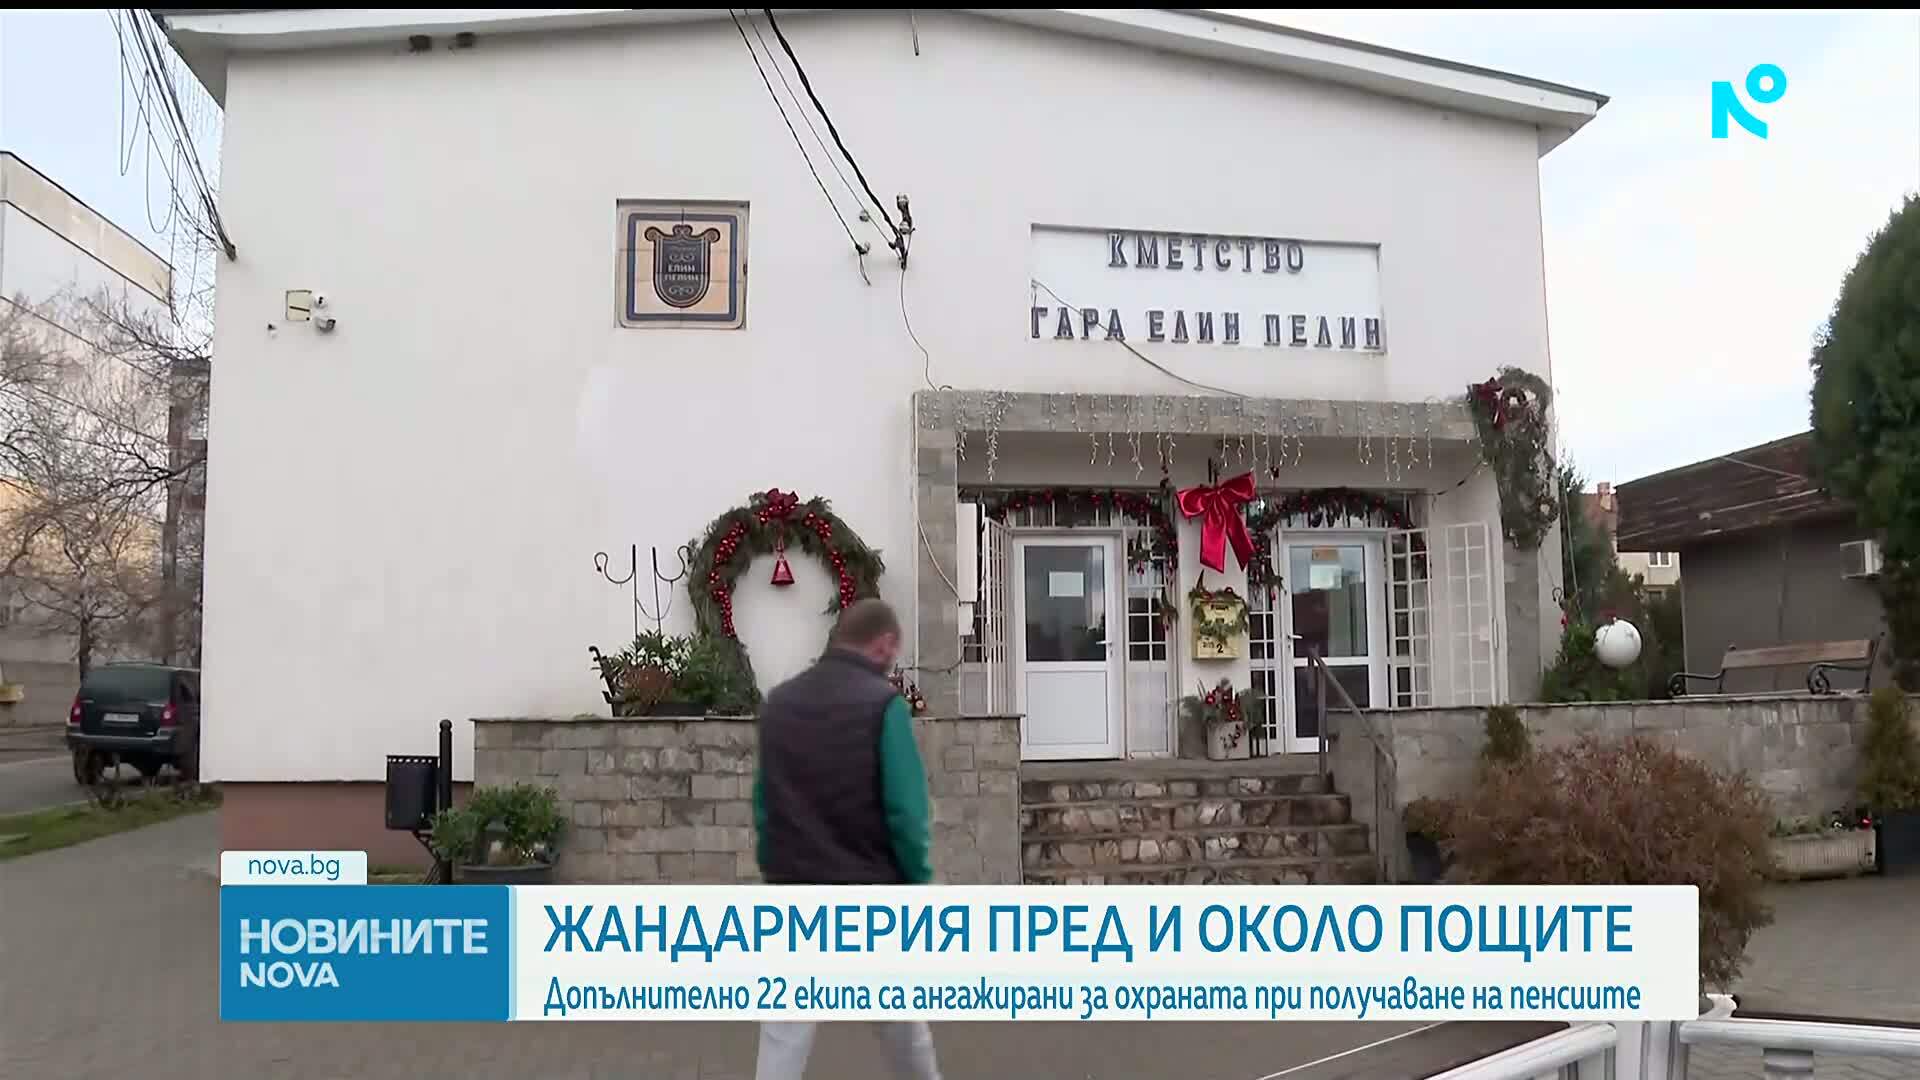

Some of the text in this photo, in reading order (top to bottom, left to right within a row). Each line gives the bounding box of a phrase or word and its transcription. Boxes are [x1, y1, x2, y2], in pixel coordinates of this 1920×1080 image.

[1107, 231, 1305, 273] КМЕТСТВО
[1031, 306, 1381, 350] ГАРА ЕЛИН ПЕЛИН
